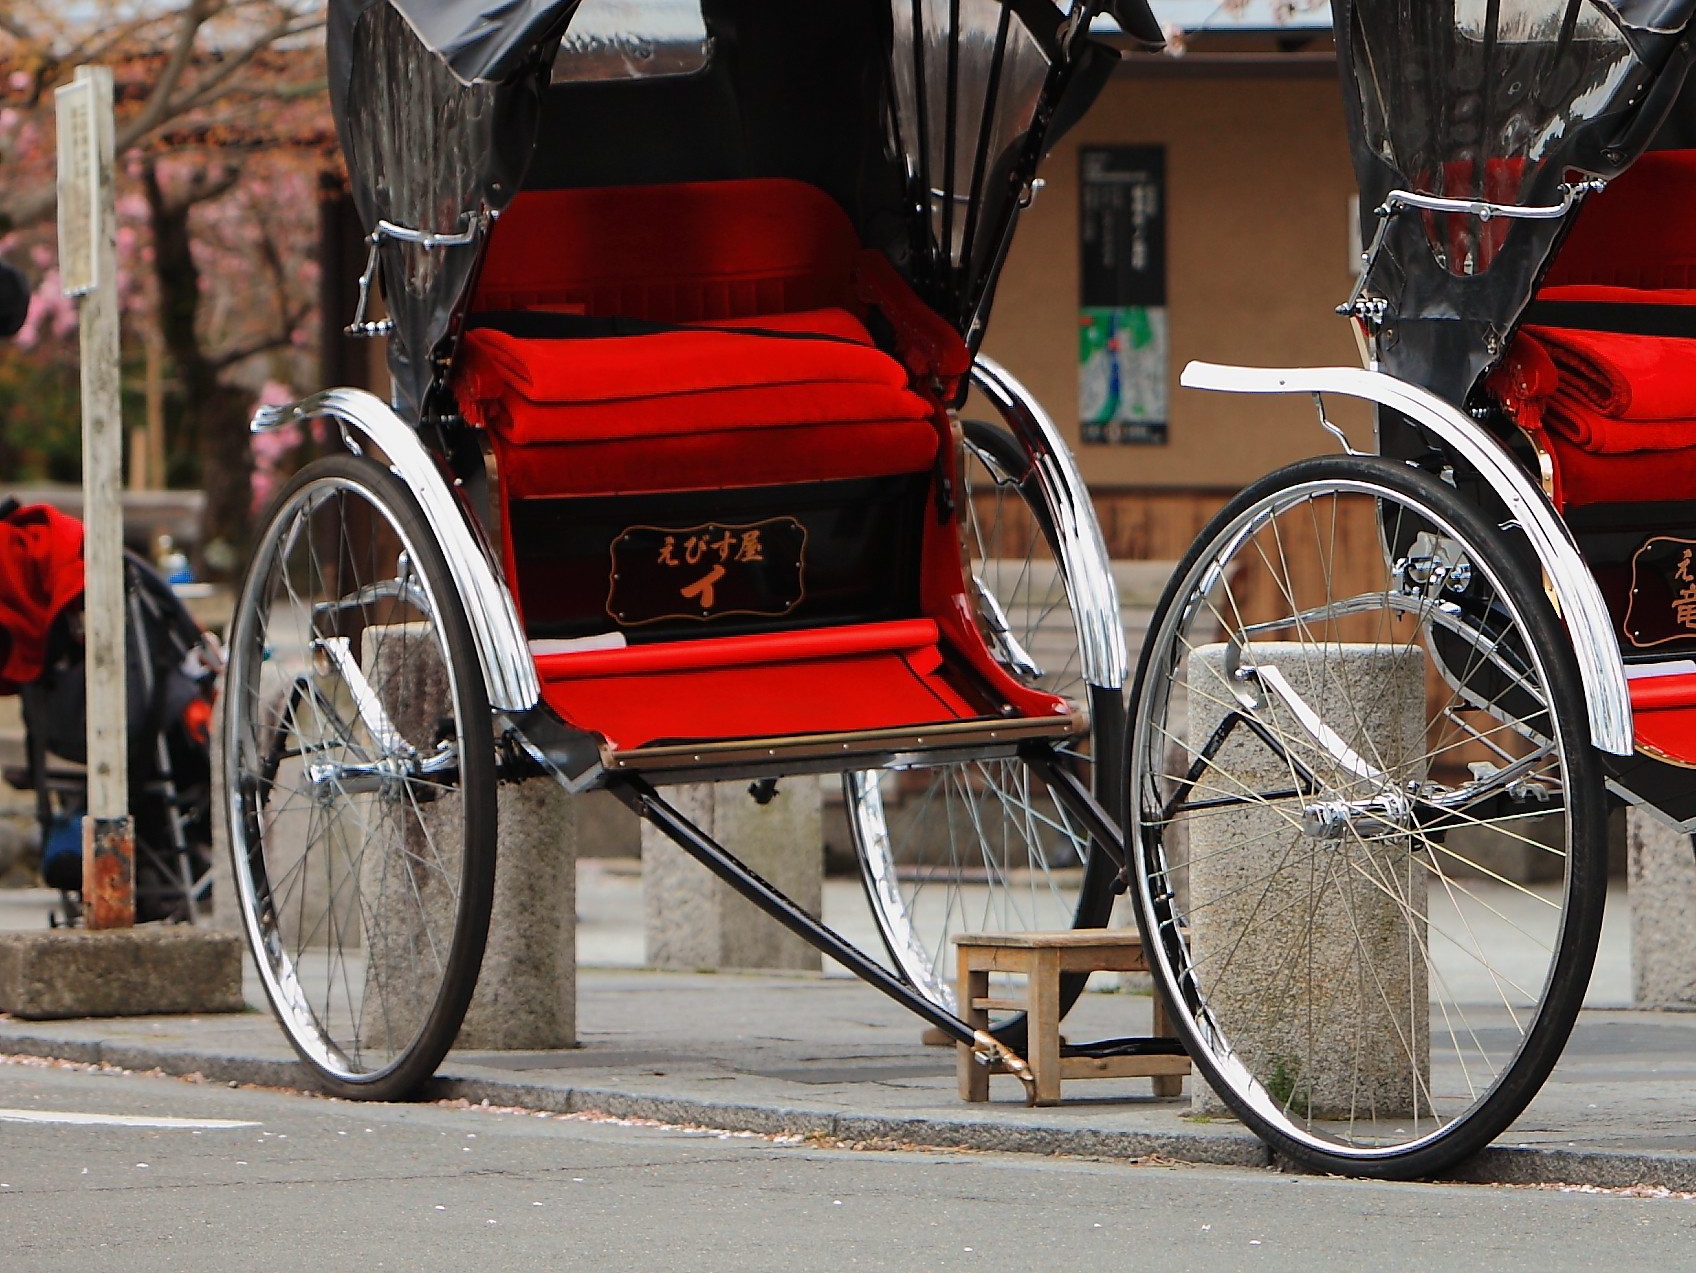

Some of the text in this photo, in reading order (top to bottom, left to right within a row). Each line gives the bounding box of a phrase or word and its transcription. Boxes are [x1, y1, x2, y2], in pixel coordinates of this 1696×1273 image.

[658, 530, 765, 566] えびす屋
[680, 565, 726, 608] イ
